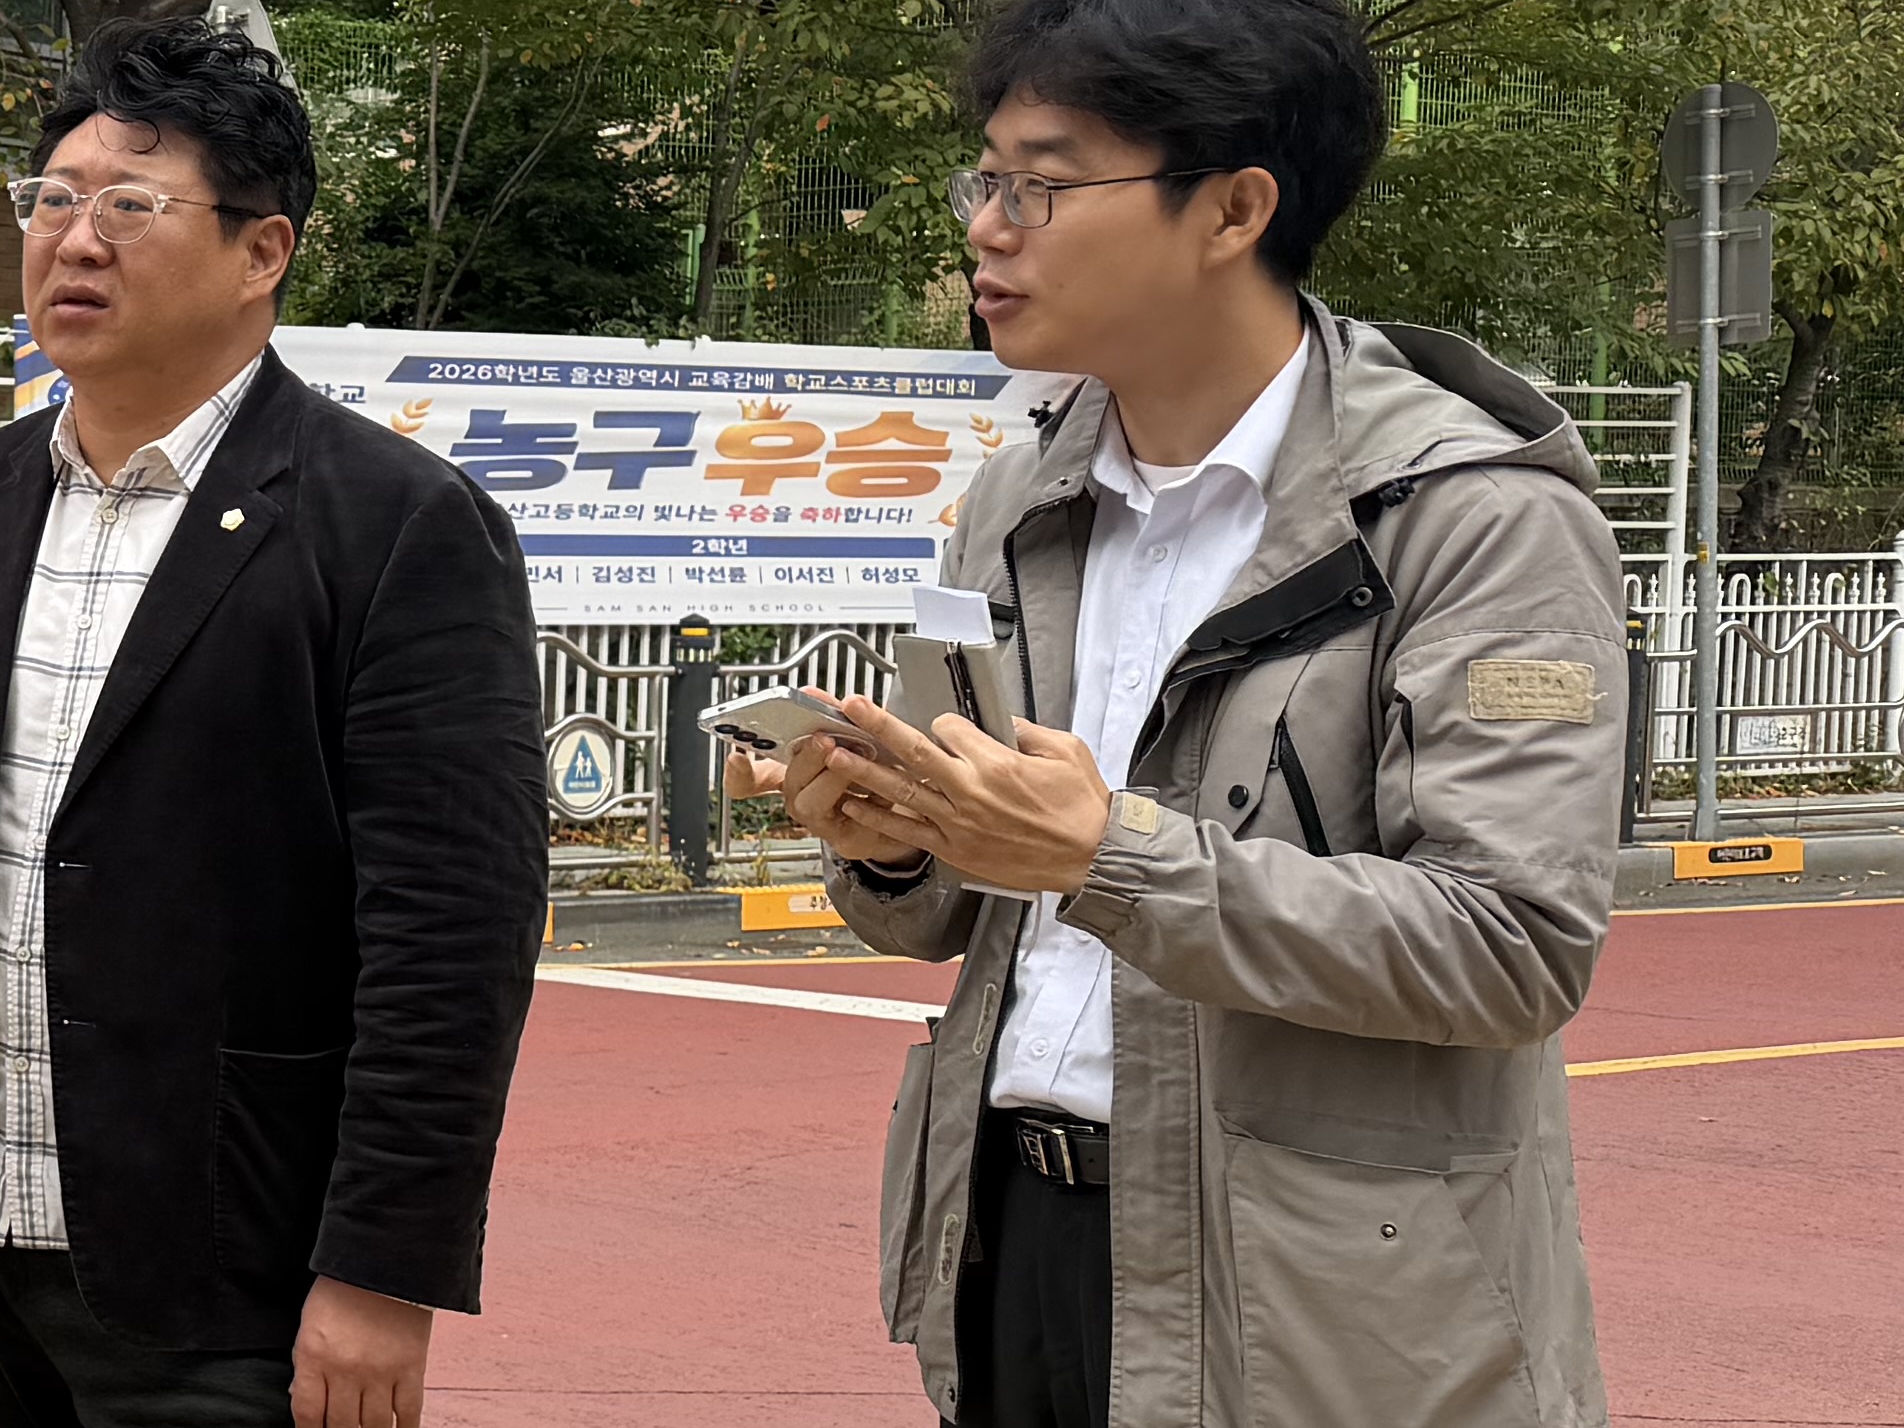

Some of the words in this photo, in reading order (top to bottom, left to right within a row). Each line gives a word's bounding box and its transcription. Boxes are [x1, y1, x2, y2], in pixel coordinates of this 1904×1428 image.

[428, 363, 561, 383] 2026학년도
[569, 367, 680, 387] 울산광역시
[688, 372, 775, 391] 교육감배
[448, 408, 703, 492] 농구
[703, 410, 953, 499] 우승
[506, 503, 645, 522] 산고등학교의
[653, 504, 718, 523] 빛나는
[725, 503, 793, 523] 우승을
[799, 506, 913, 525] 축하합니다!
[692, 538, 748, 556] 2학년
[592, 565, 657, 584] 김성진
[774, 566, 835, 584] 이서진
[861, 566, 922, 584] 허성모
[584, 604, 622, 613] SAM
[636, 604, 672, 613] SAN
[686, 604, 734, 613] HIGH
[748, 603, 825, 613] SCHOOL
